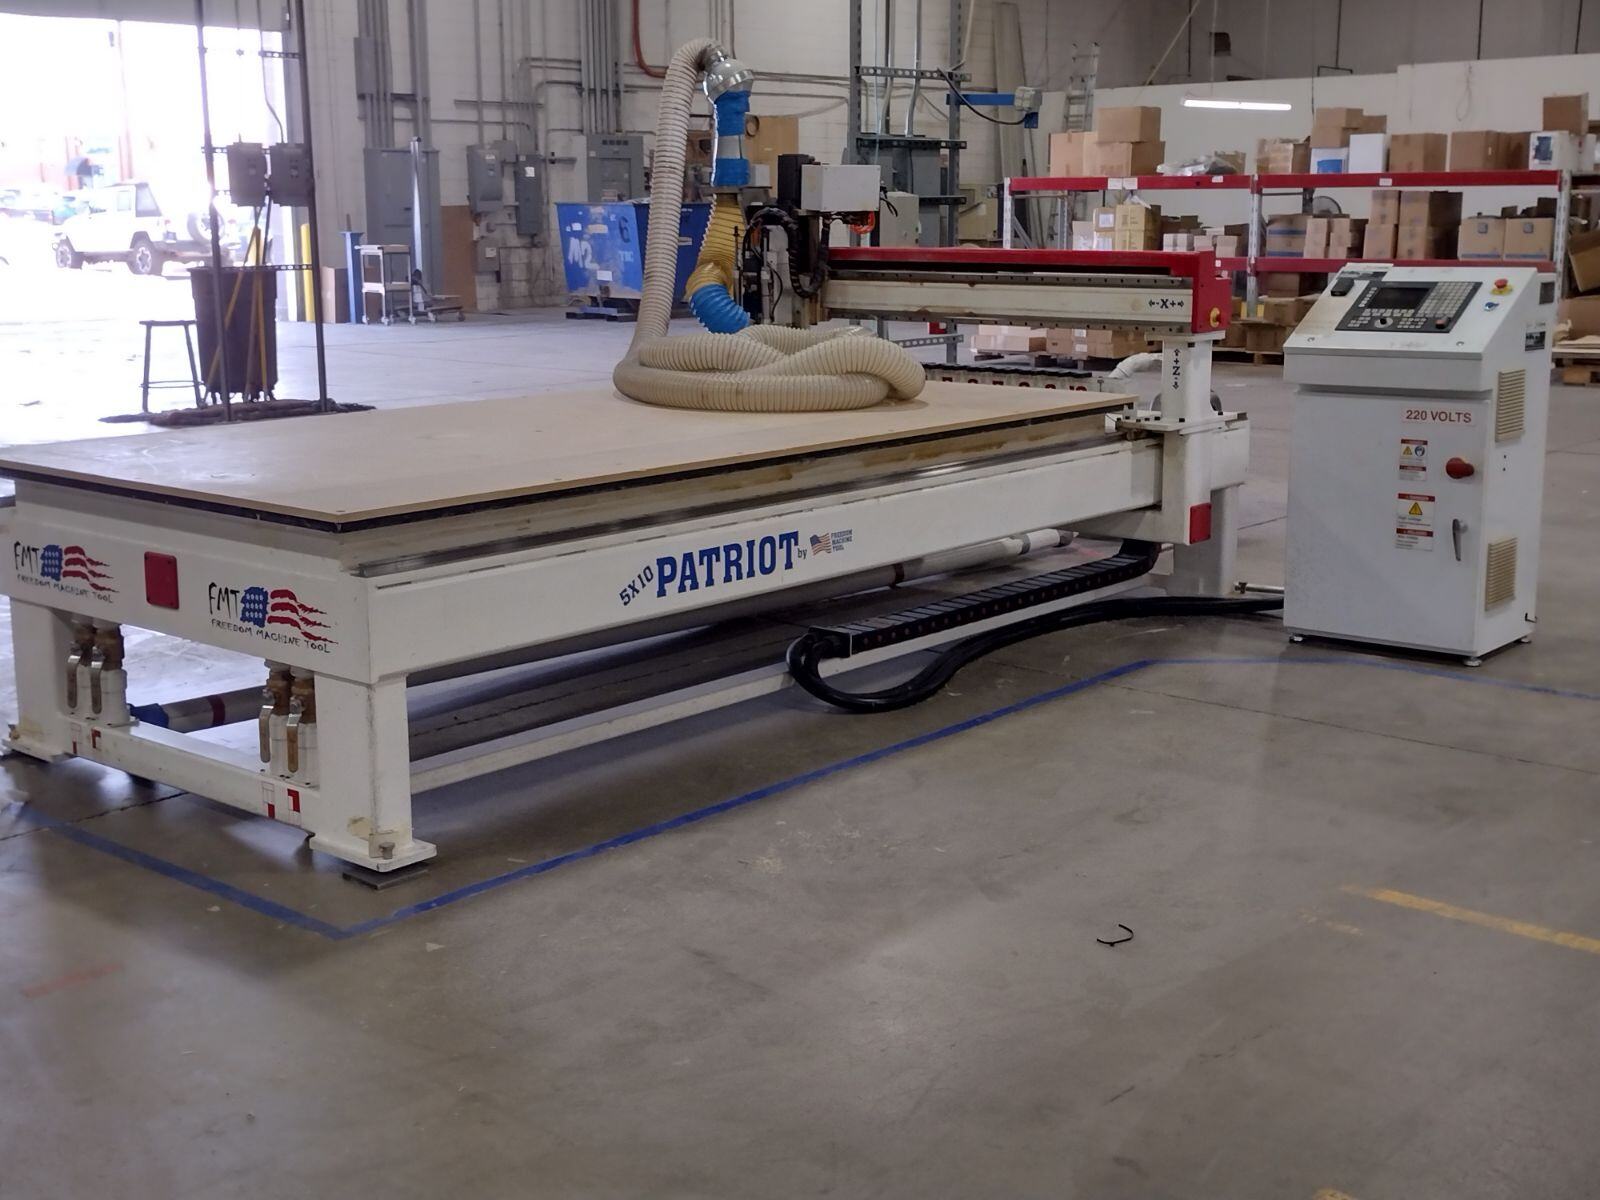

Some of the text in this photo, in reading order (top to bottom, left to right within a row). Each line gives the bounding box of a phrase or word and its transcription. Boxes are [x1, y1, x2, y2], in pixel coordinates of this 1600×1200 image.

[1406, 409, 1472, 423] 220 VOLTS
[14, 541, 40, 574] FMT
[619, 530, 808, 606] 5X10 PATRIOT by
[92, 591, 114, 603] TOOL
[208, 582, 240, 618] FMT
[211, 618, 331, 653] FREEDOM MACHINE TOOL
